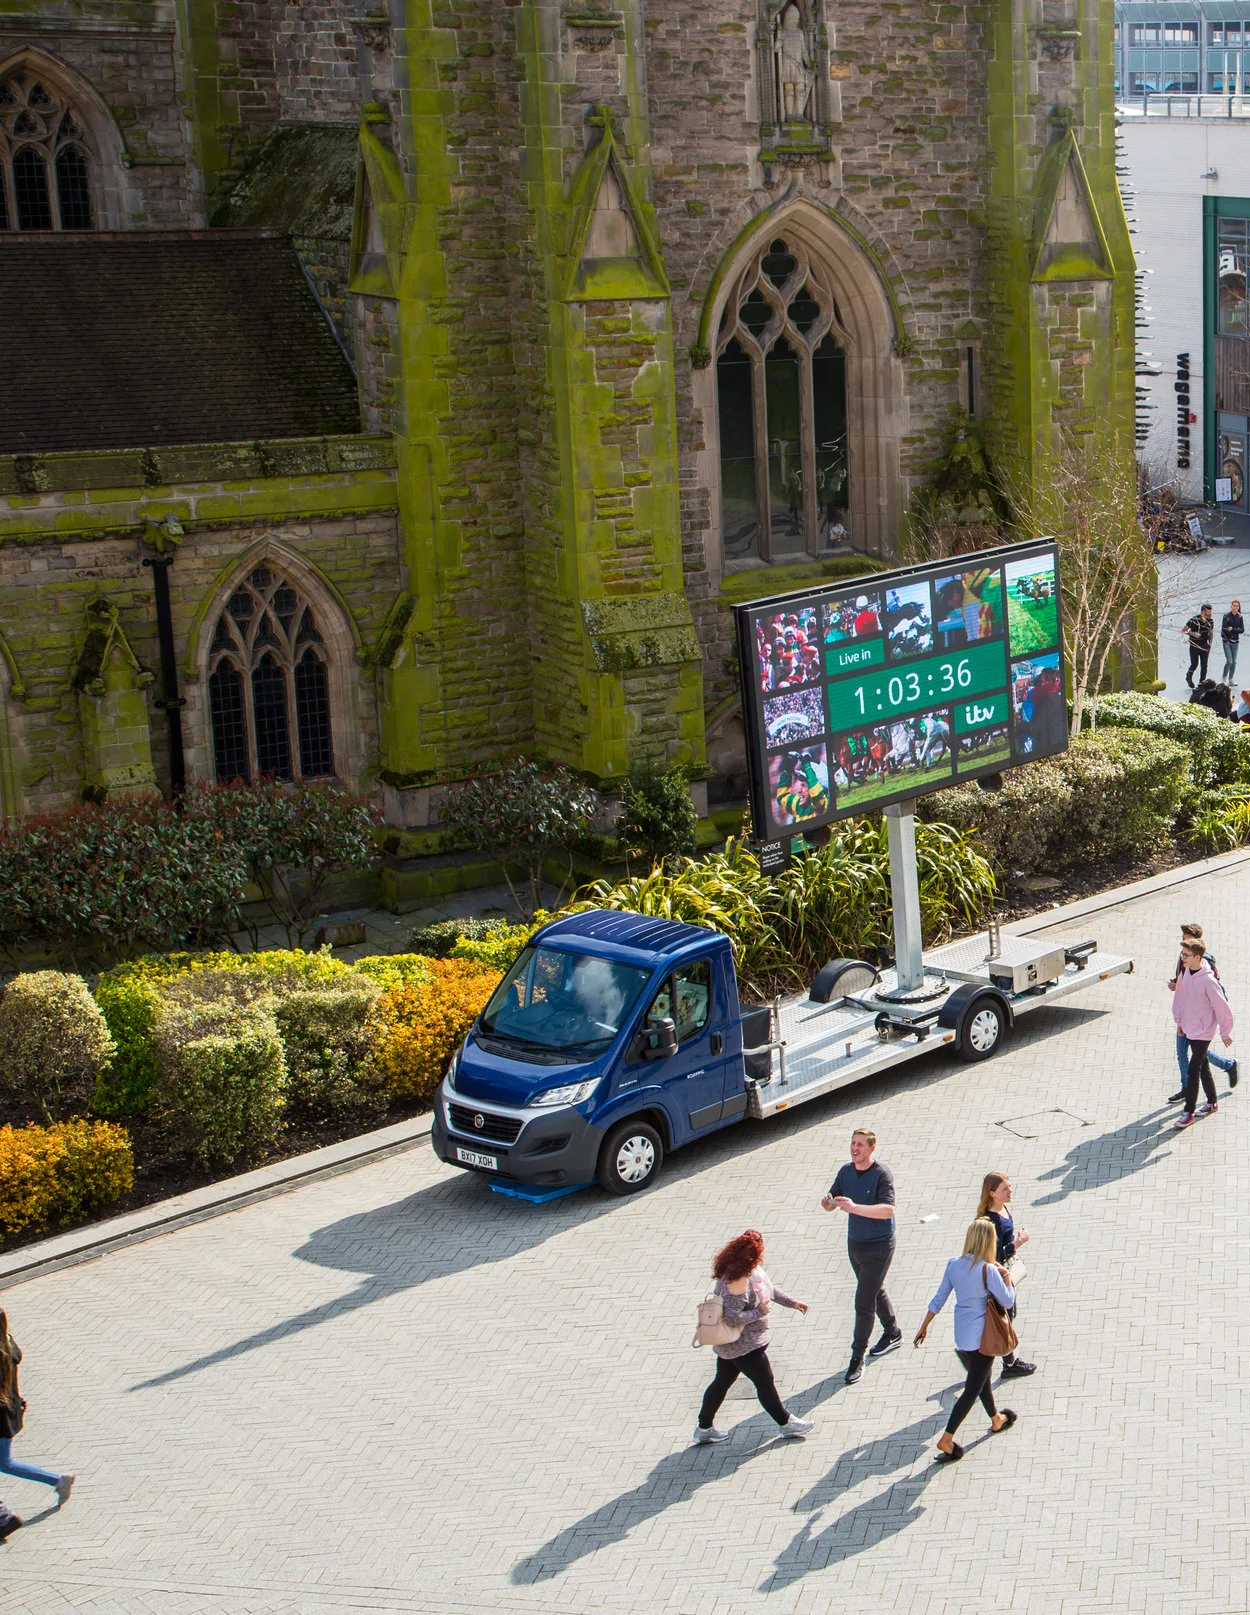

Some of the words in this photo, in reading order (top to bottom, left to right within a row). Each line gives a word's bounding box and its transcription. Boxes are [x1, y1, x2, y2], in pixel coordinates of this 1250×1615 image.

[1174, 352, 1191, 469] wagamama
[838, 653, 860, 666] Live
[861, 649, 871, 661] in
[854, 659, 972, 715] 1:03:36
[965, 705, 995, 725] itv
[762, 842, 782, 853] NOTICE
[461, 1150, 476, 1163] BX17
[477, 1155, 493, 1167] XOH
